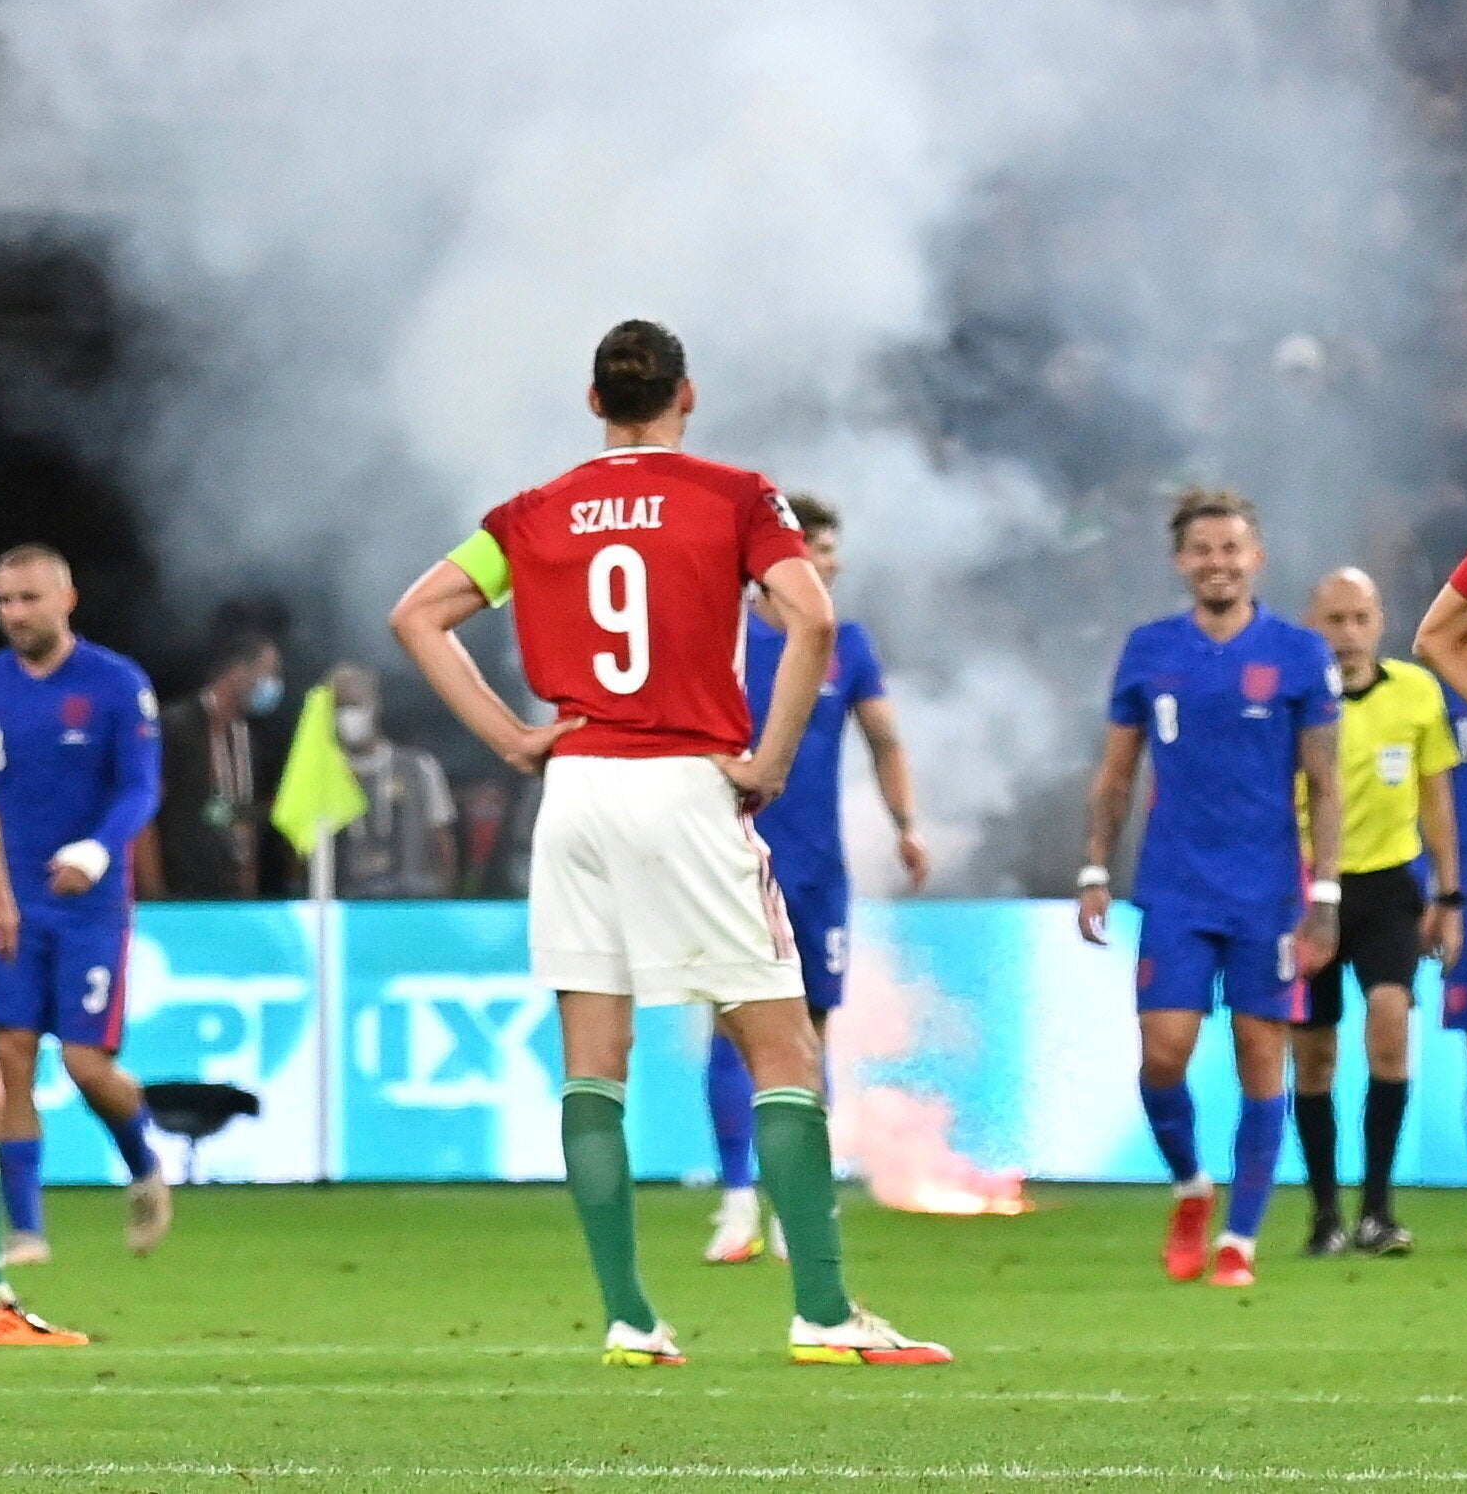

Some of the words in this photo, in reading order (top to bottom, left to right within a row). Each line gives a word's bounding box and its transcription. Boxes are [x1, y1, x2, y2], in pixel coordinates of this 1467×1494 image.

[569, 495, 665, 535] SZALAI
[587, 543, 650, 695] 9
[82, 964, 113, 1014] 3
